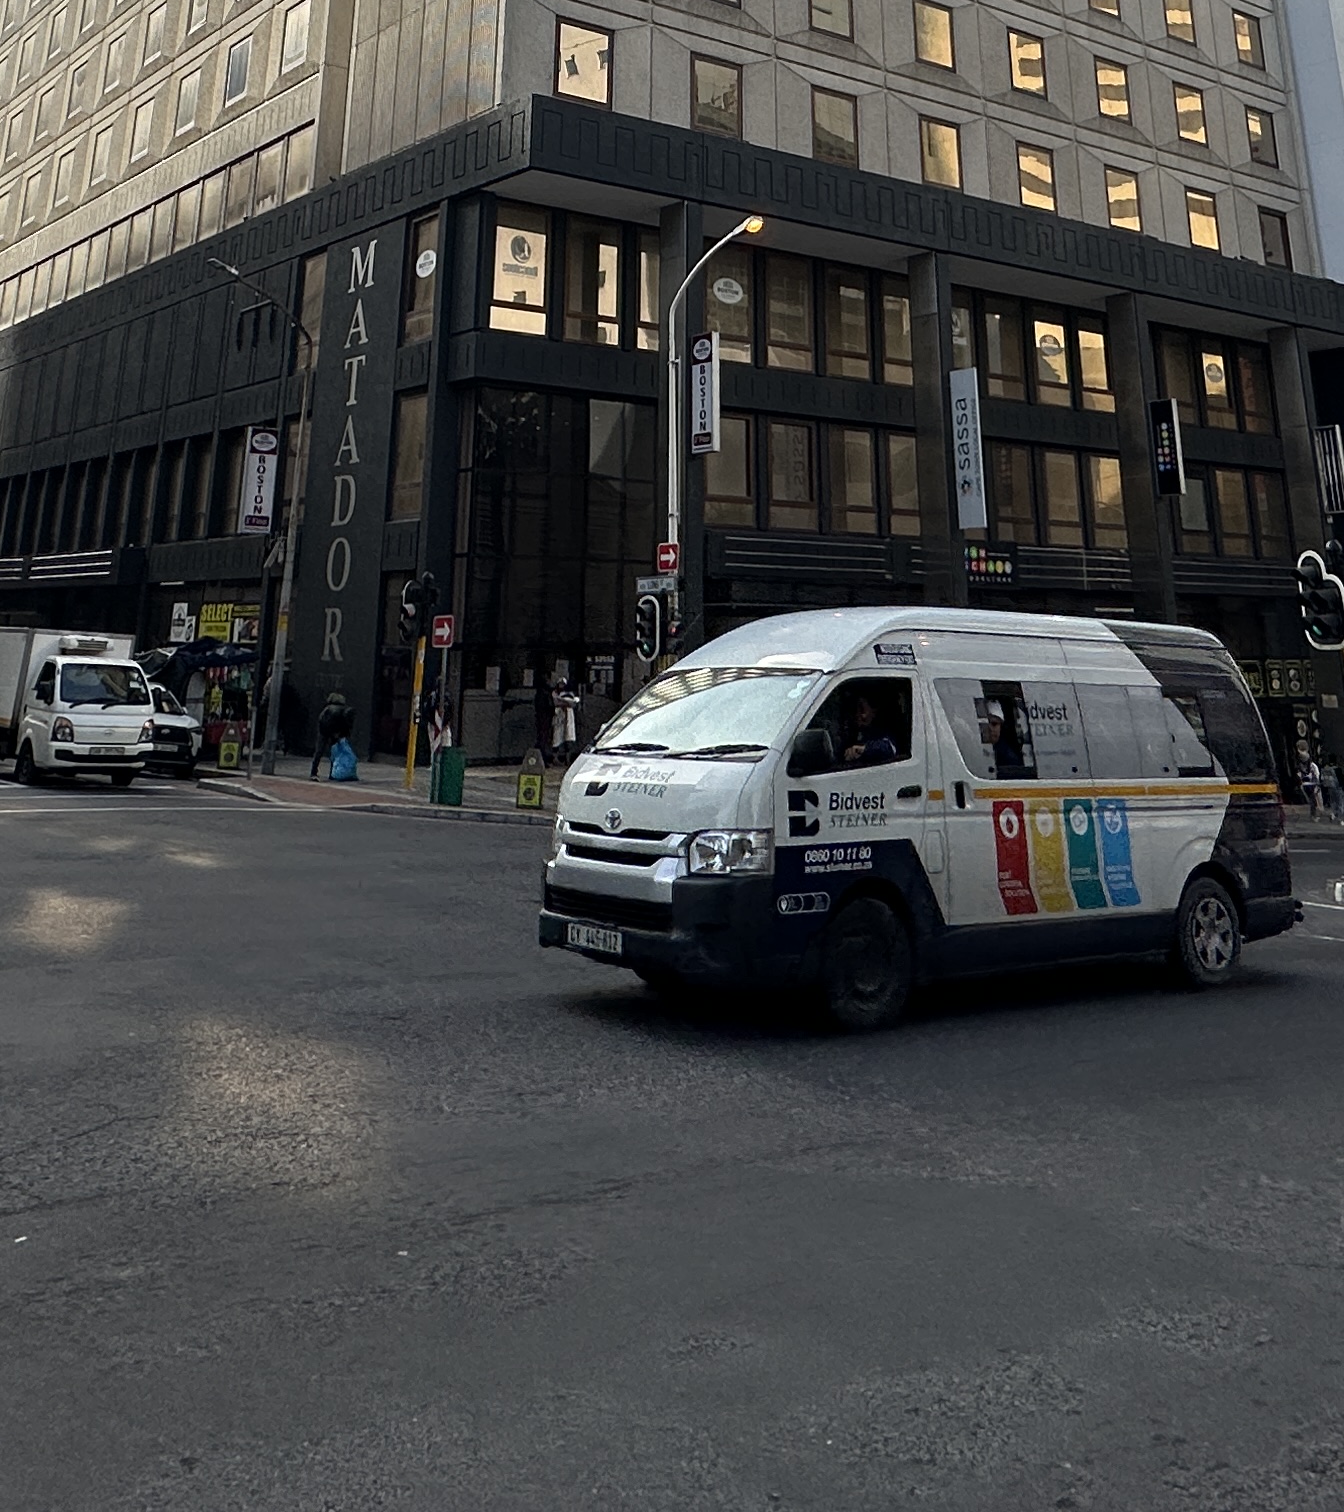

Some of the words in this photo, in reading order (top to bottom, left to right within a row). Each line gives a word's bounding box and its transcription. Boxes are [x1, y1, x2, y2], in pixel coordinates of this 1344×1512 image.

[699, 365, 707, 431] BOSTON
[955, 397, 970, 470] sassa
[321, 240, 377, 661] MATADOR
[253, 455, 266, 514] BOSTON
[202, 604, 234, 622] SELECT
[613, 782, 668, 798] STEINER
[829, 792, 885, 811] Bidvest
[829, 813, 889, 829] STEINER
[832, 848, 844, 861] 10
[846, 847, 858, 861] 11
